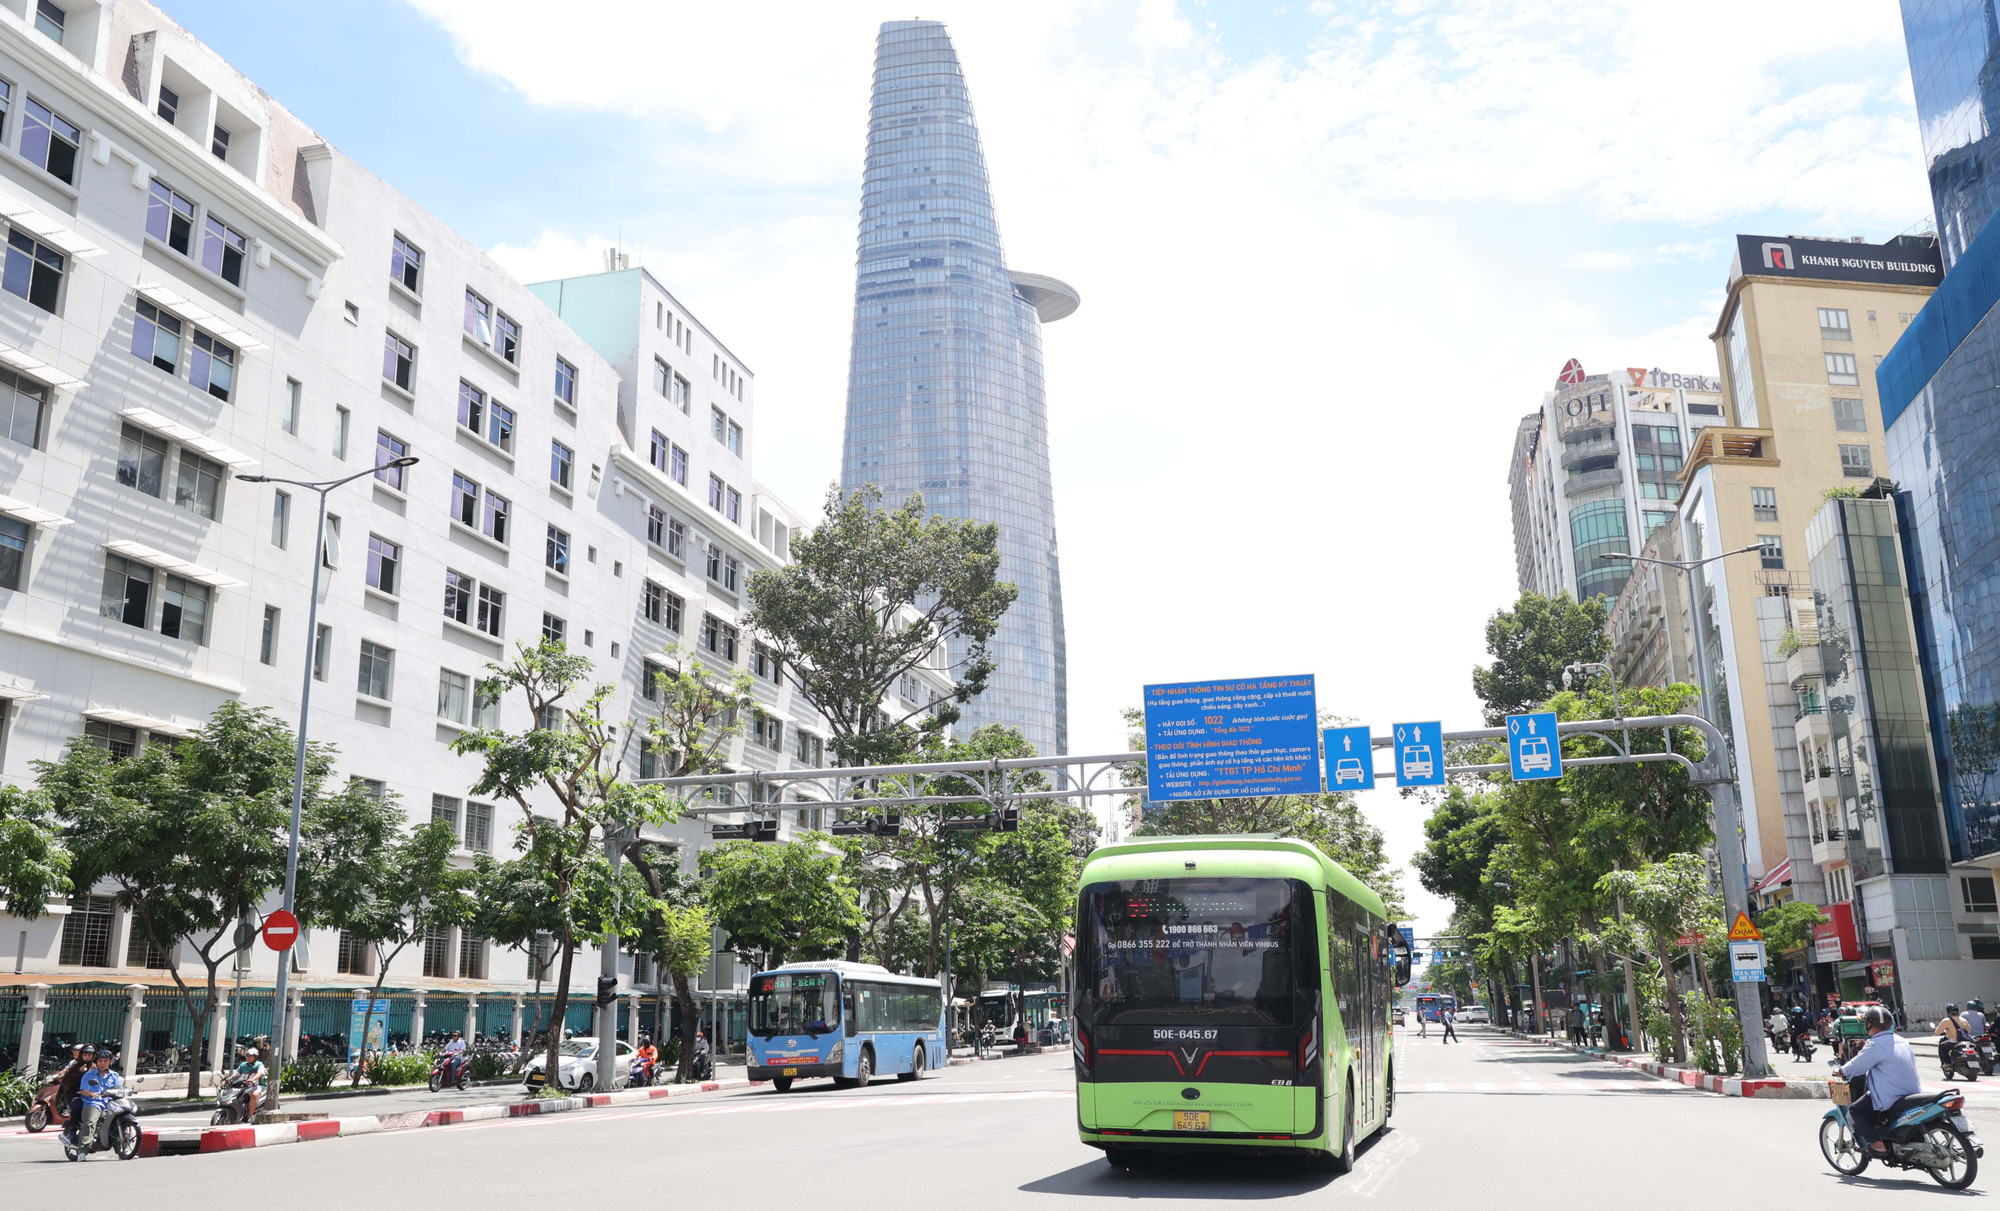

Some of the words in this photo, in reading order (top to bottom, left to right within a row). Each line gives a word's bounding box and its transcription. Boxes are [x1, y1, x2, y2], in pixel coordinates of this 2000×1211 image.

[1801, 255, 1839, 266] KHANH
[1841, 258, 1884, 270] NGUYEN
[1886, 262, 1936, 274] BUILDING
[1649, 369, 1710, 390] TPBank
[1168, 926, 1186, 934] 1900
[1188, 925, 1202, 933] 866
[1203, 925, 1218, 933] 663
[1138, 940, 1154, 948] 355
[1156, 940, 1170, 948] 222
[1153, 1030, 1218, 1039] 50E-645.67
[1177, 1122, 1205, 1130] 645.67
